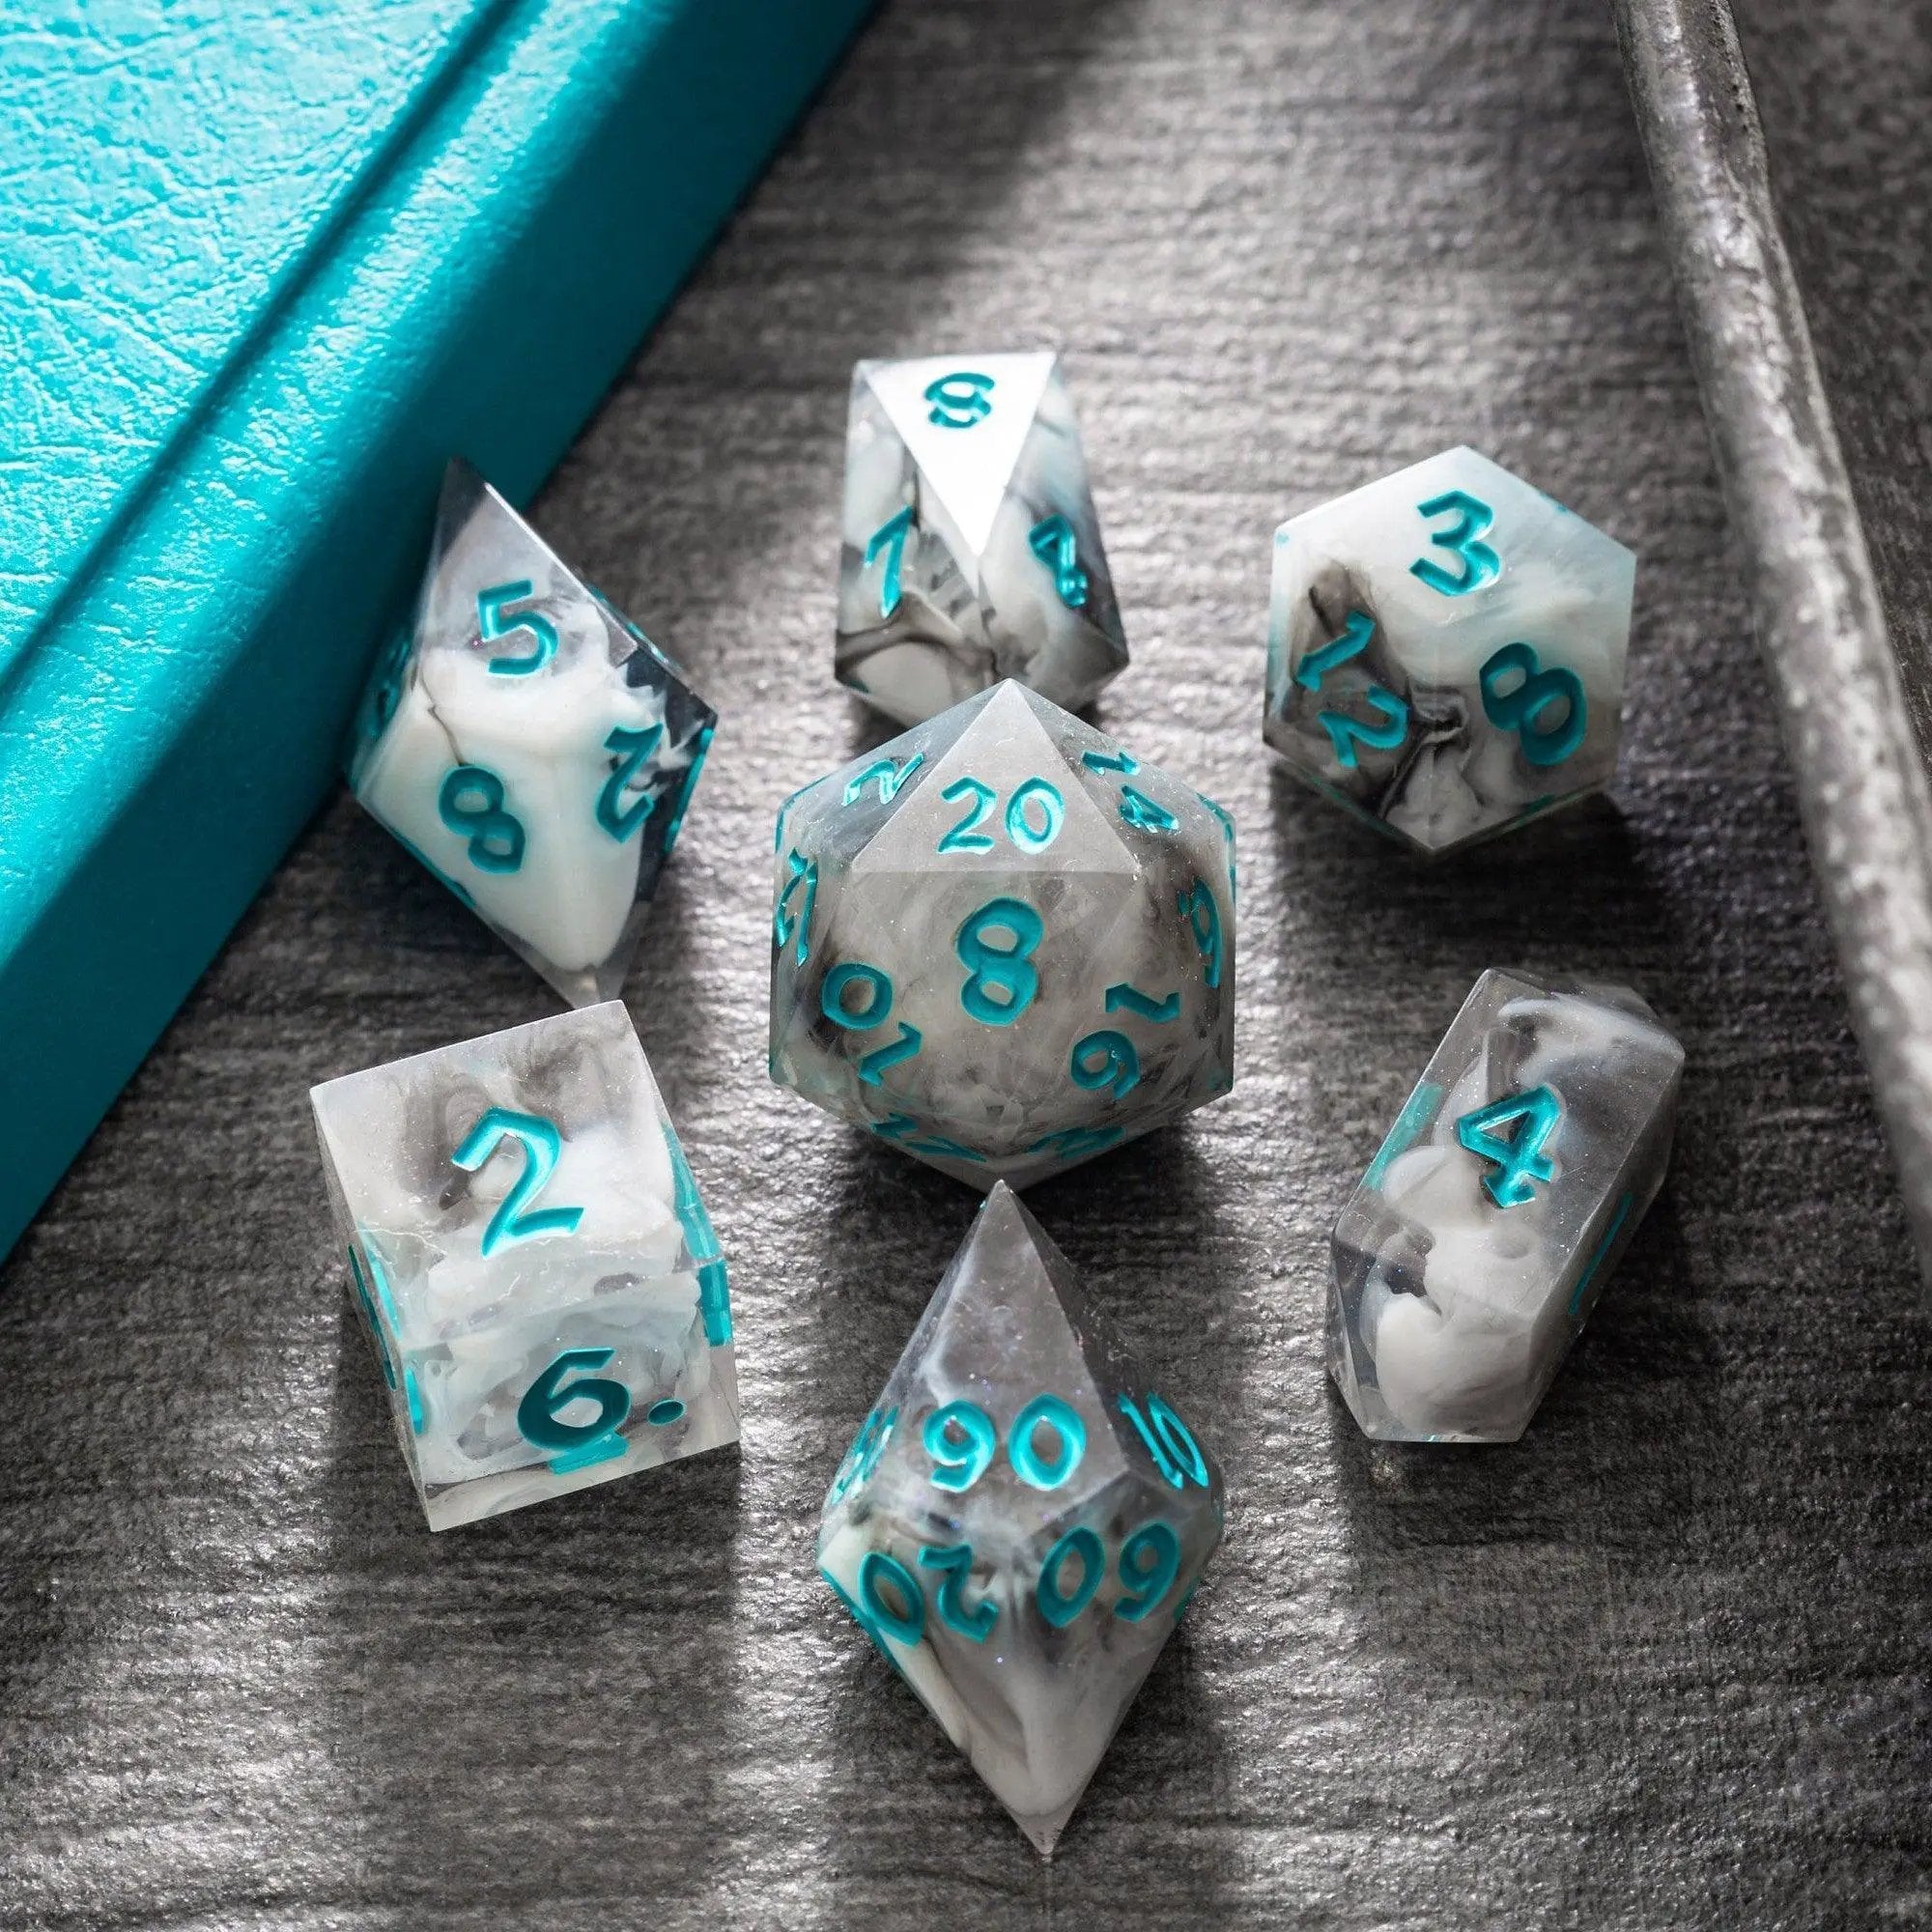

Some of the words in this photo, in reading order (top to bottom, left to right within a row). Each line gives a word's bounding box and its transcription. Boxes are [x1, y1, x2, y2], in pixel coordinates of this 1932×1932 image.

[1028, 514, 1089, 608] 4
[1409, 490, 1500, 596] 3
[476, 580, 558, 676] 5
[1296, 611, 1411, 769] 12
[1479, 642, 1587, 765] 8
[439, 766, 526, 875] 8
[595, 723, 664, 843] 2
[937, 776, 1065, 854] 20
[1081, 749, 1179, 833] 14
[956, 896, 1044, 1027] 8
[821, 962, 923, 1089] 10
[452, 1105, 584, 1258] 2
[1456, 1082, 1564, 1209] 4
[923, 1392, 1087, 1493] 90
[1116, 1391, 1209, 1490] 10
[859, 1543, 1000, 1648] 20
